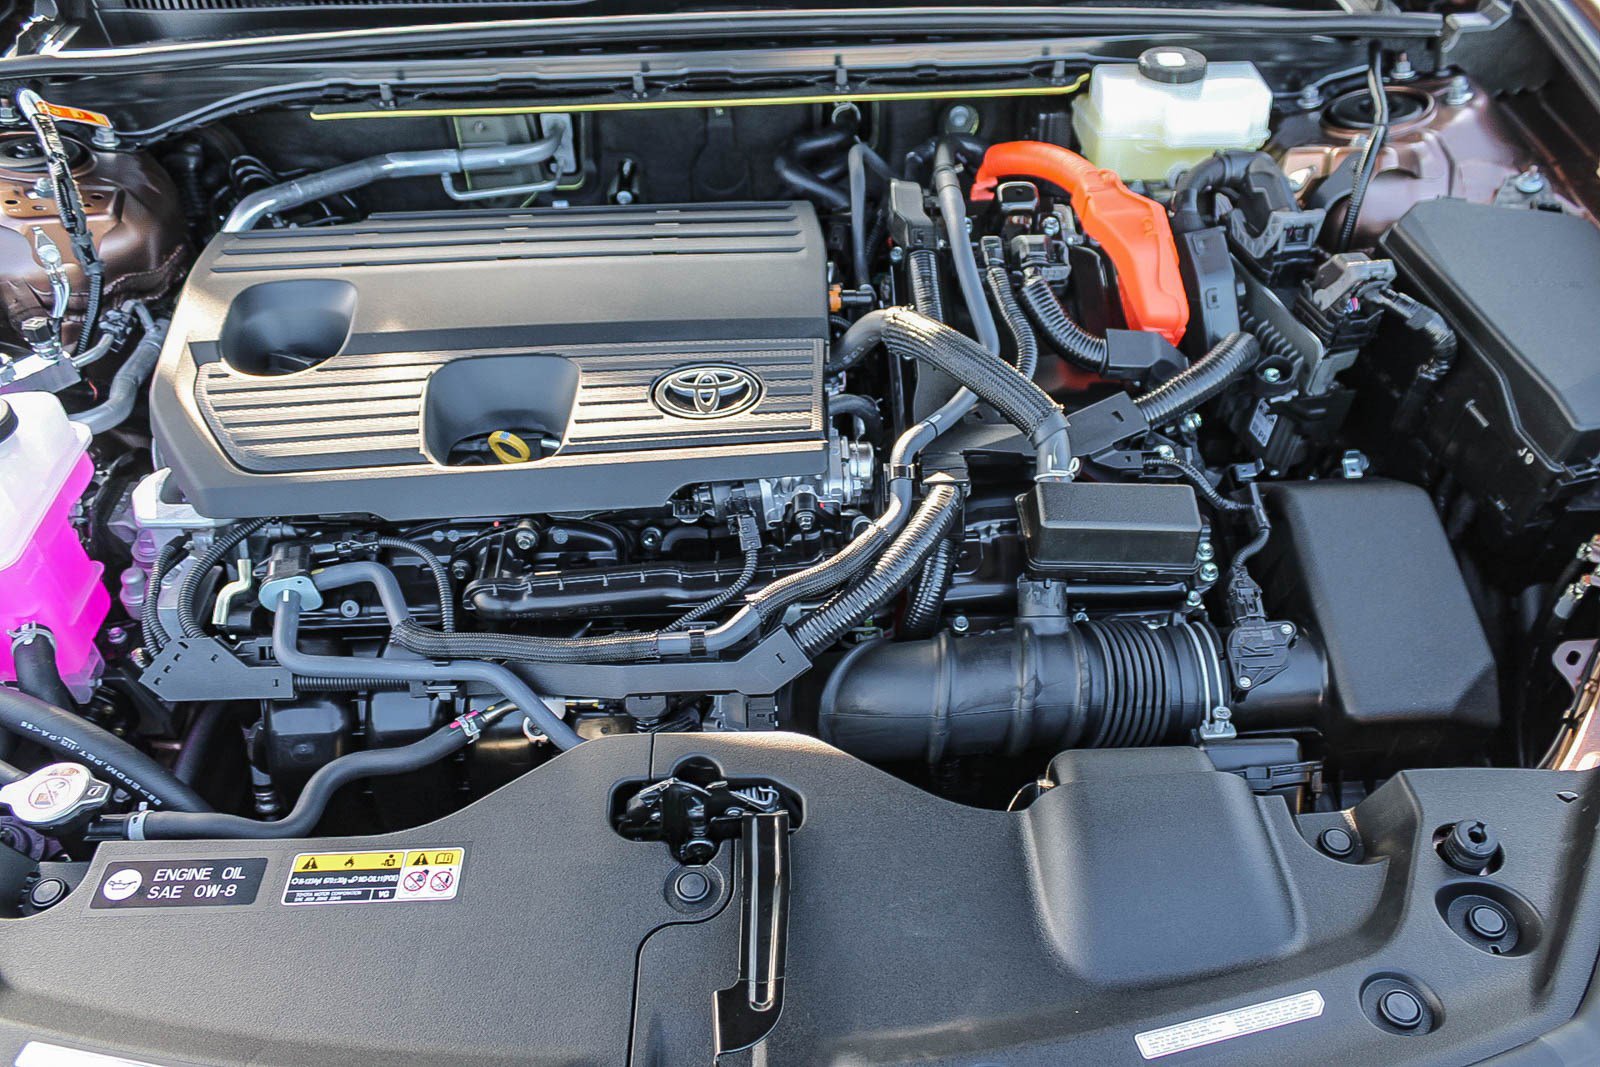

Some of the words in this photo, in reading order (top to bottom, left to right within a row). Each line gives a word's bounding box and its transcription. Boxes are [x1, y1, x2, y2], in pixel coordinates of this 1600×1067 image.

[153, 868, 214, 881] ENGINE
[222, 867, 246, 880] OIL
[147, 885, 185, 899] SAE
[194, 884, 237, 898] 0W-8
